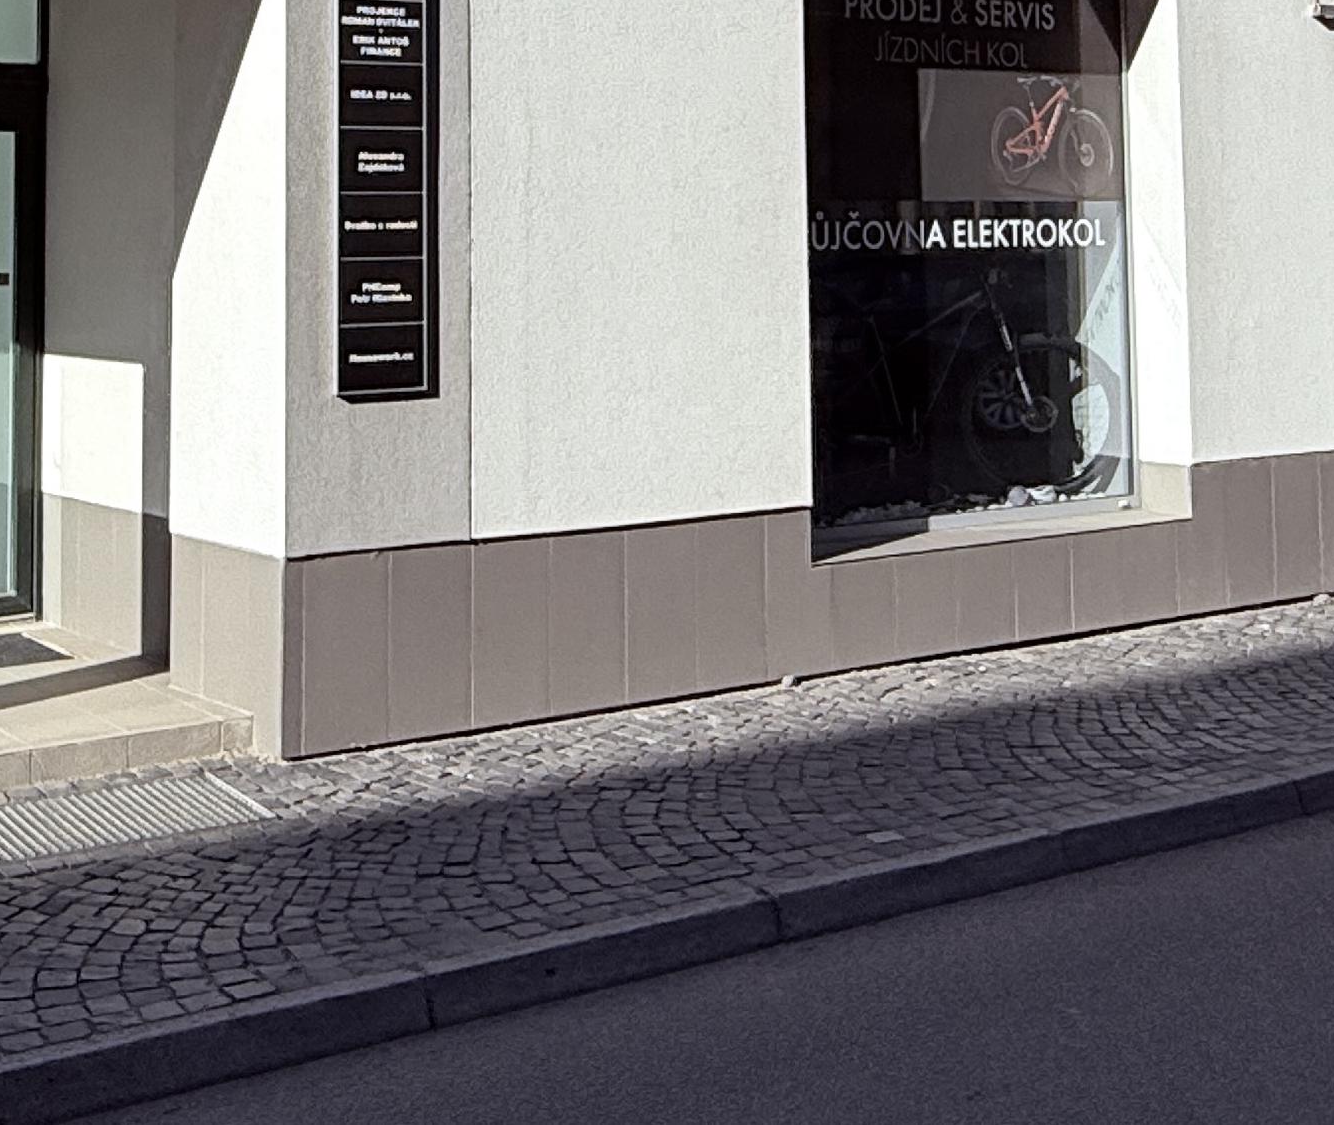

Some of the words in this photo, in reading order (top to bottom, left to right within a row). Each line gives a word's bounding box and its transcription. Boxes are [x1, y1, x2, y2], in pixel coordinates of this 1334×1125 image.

[874, 30, 981, 66] JÍZDNÍCH
[986, 40, 1029, 68] KOL
[953, 218, 1106, 249] ELEKTROKOL
